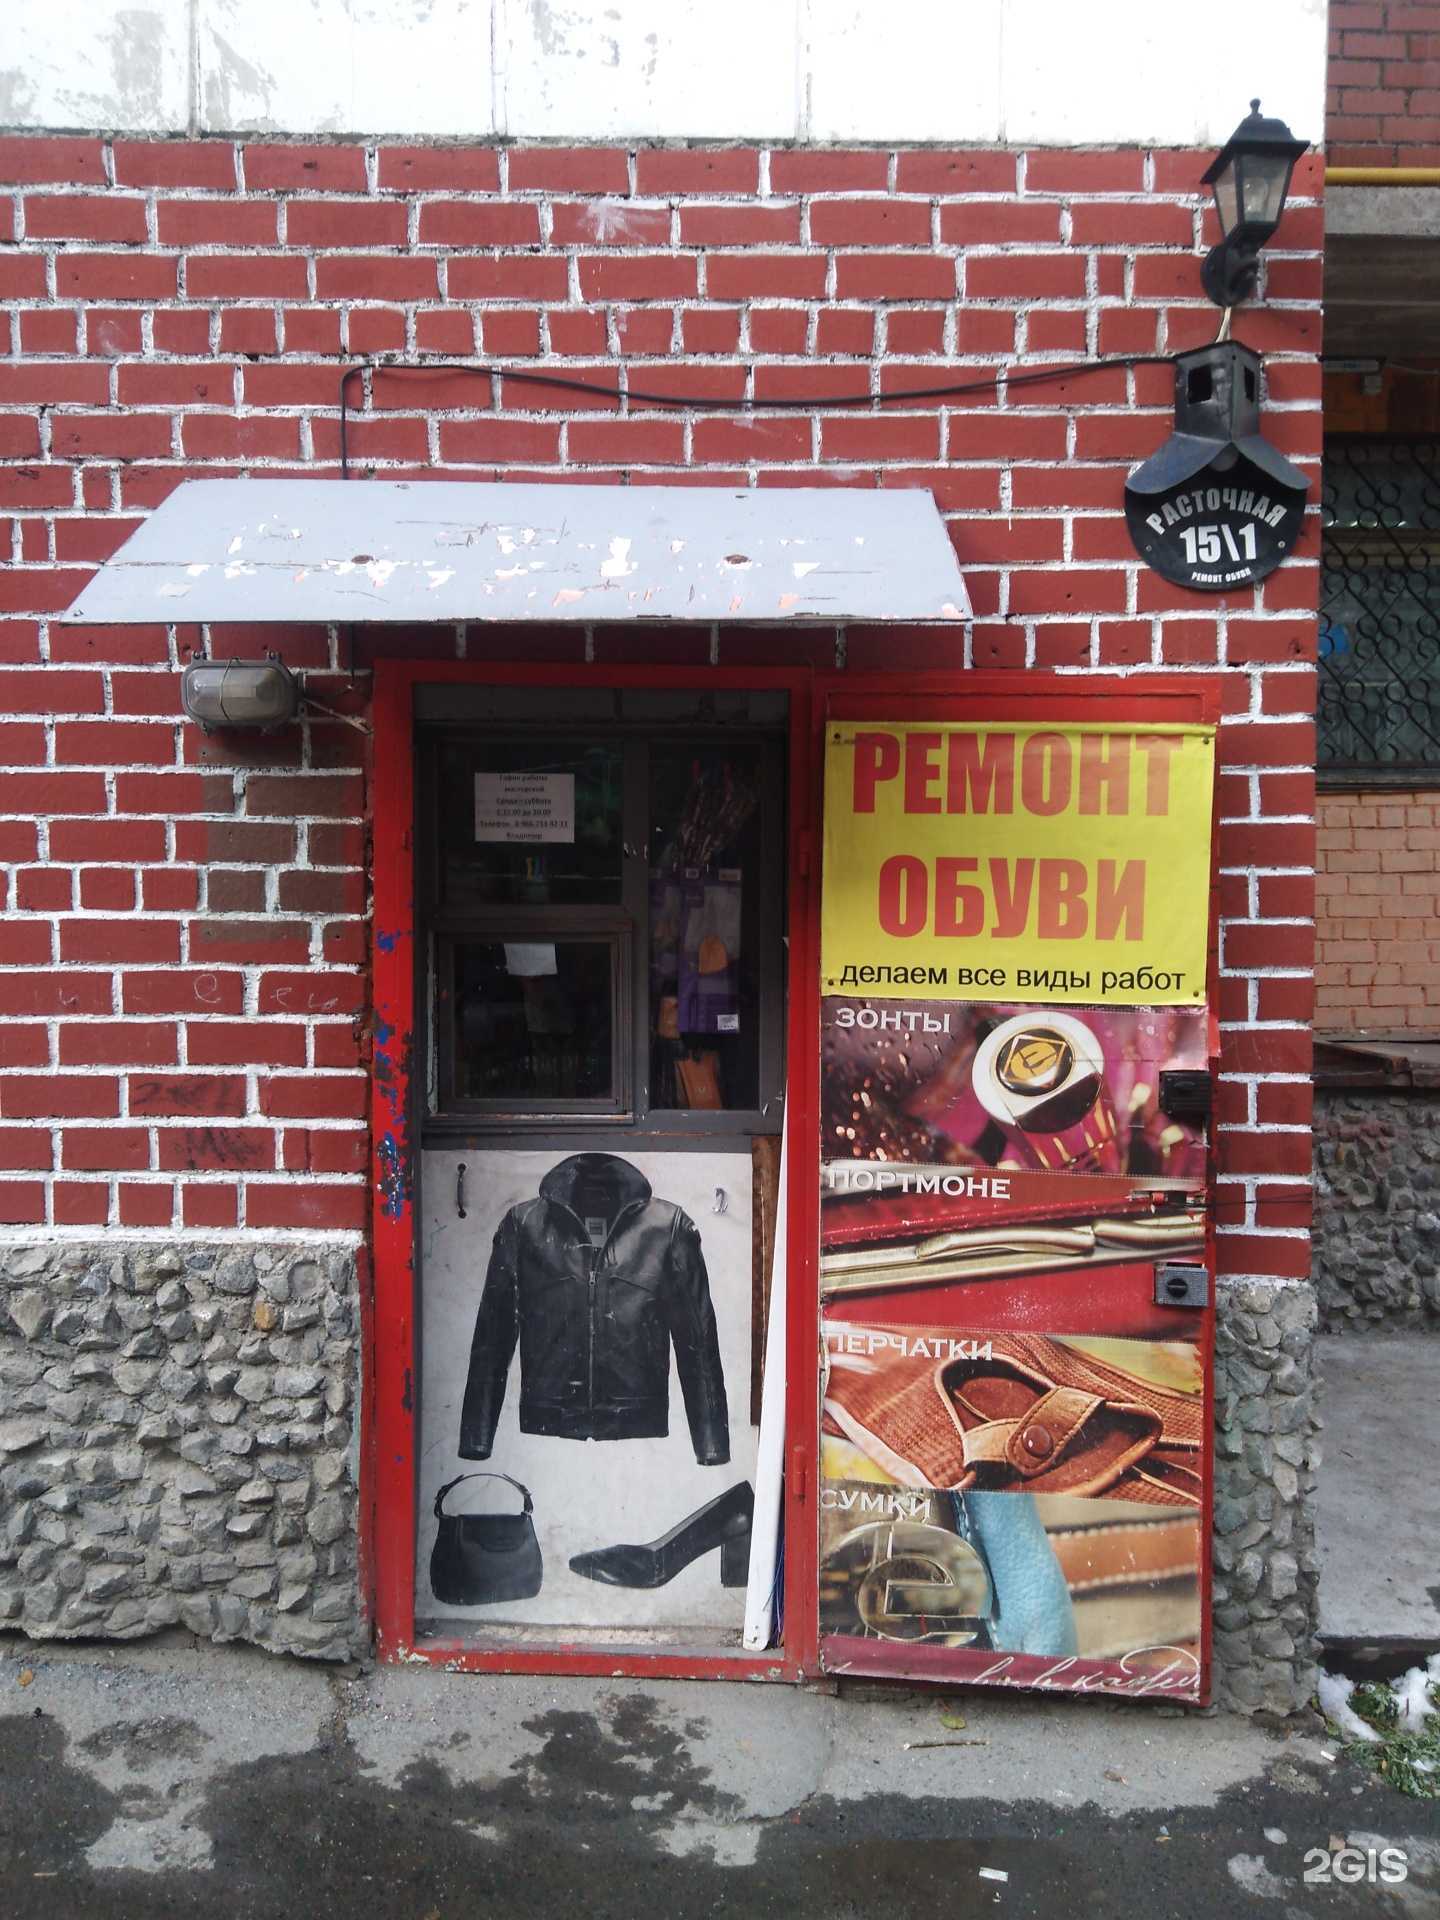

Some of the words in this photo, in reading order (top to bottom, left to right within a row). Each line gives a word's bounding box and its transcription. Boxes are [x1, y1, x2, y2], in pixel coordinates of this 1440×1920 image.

[1146, 488, 1288, 536] РАСТОЧНАЯ
[1179, 522, 1257, 564] 15\1
[1191, 571, 1223, 583] РЕМОНТ
[1225, 567, 1252, 583] ОБУВИ
[852, 732, 1185, 817] РЕМОНТ
[878, 854, 1147, 942] ОБУВИ
[840, 964, 948, 986] делаем
[957, 967, 1007, 987] все
[1016, 968, 1091, 992] виды
[1102, 965, 1187, 995] работ
[835, 1007, 951, 1034] ЗОНТЫ
[828, 1166, 1011, 1200] ПОРТМОНЕ
[825, 1332, 993, 1362] ПЕРЧАТКИ
[821, 1488, 932, 1522] СУМКИ
